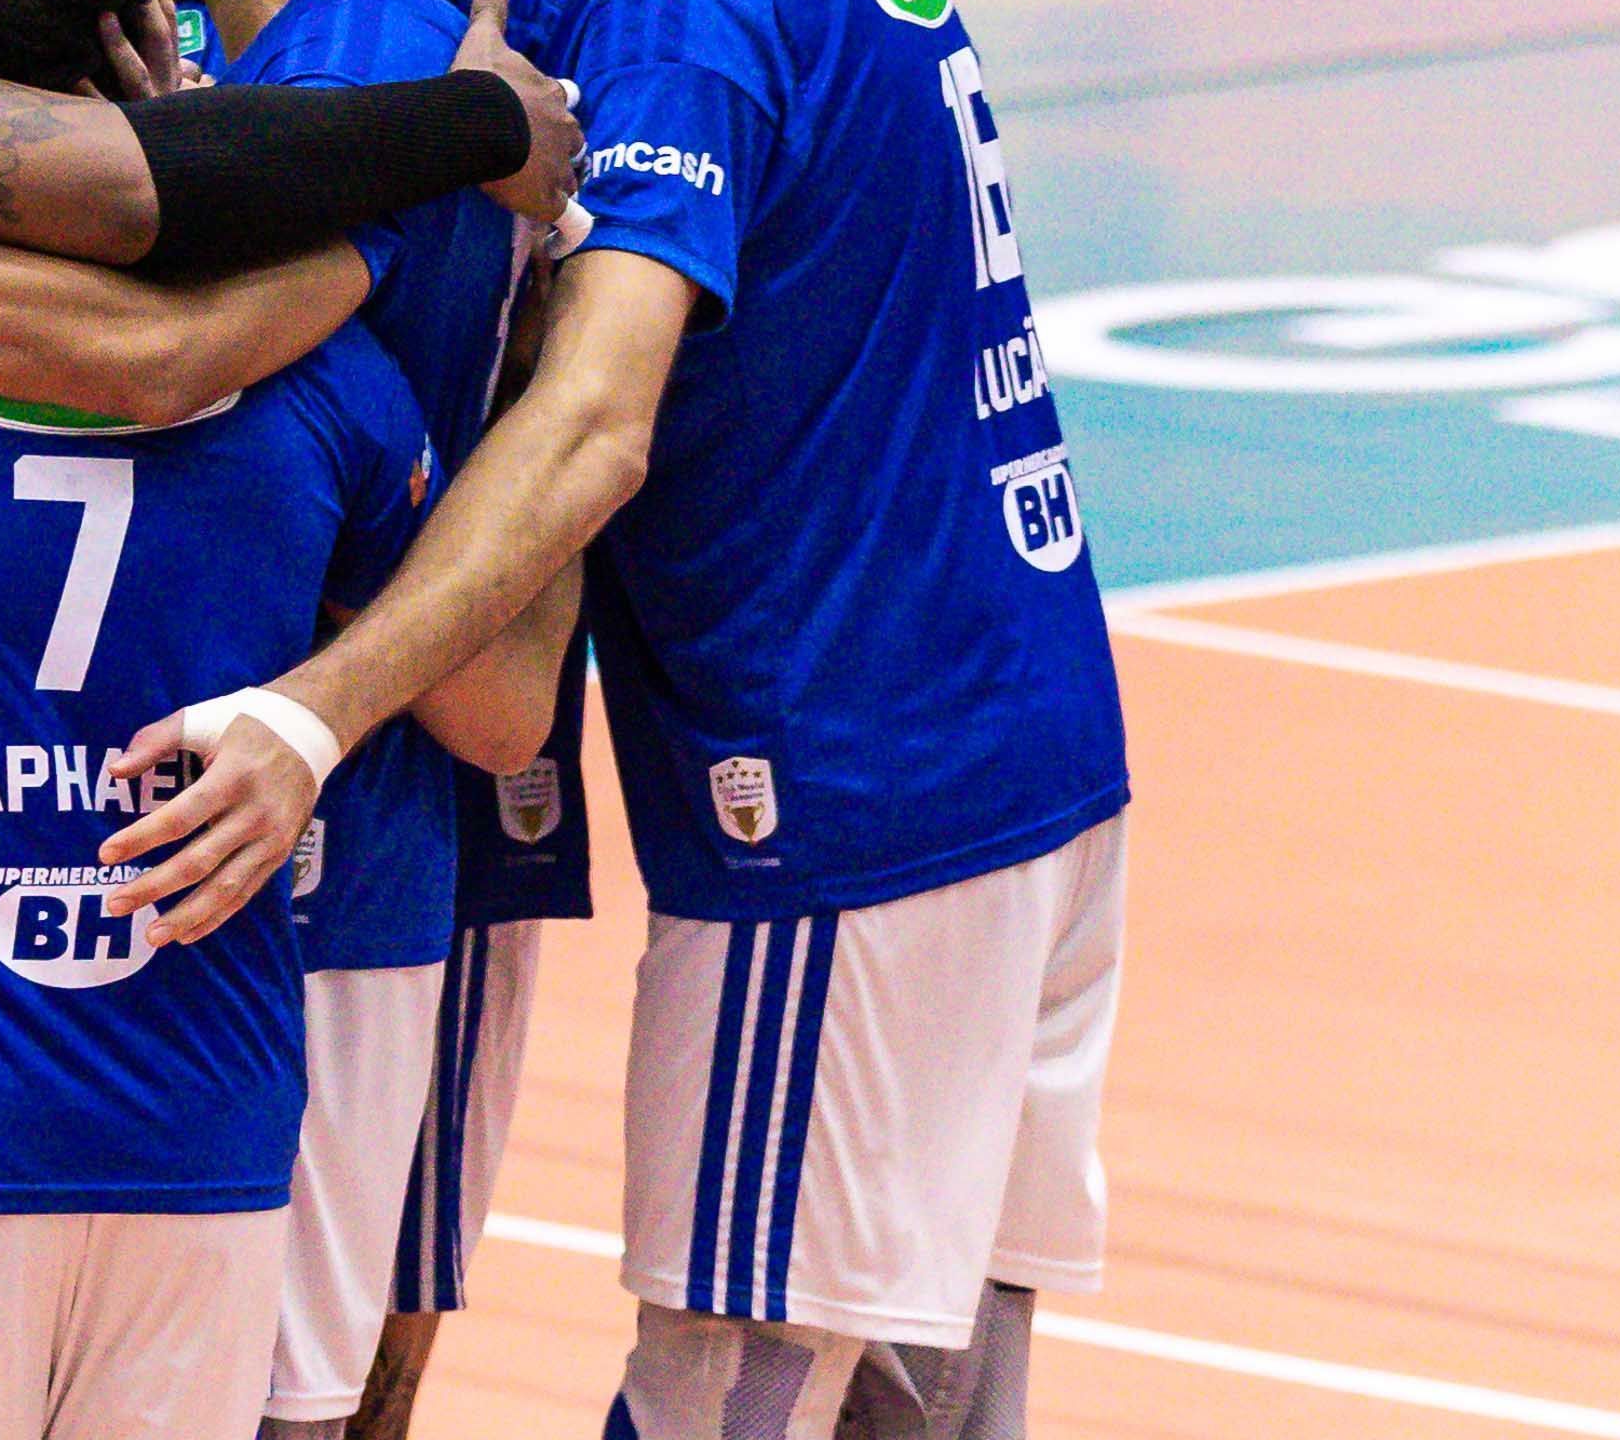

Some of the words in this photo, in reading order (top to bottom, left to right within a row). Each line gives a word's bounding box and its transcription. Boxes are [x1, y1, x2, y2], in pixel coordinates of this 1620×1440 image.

[1015, 473, 1075, 552] BH
[13, 454, 135, 692] 7
[12, 895, 140, 961] BH
